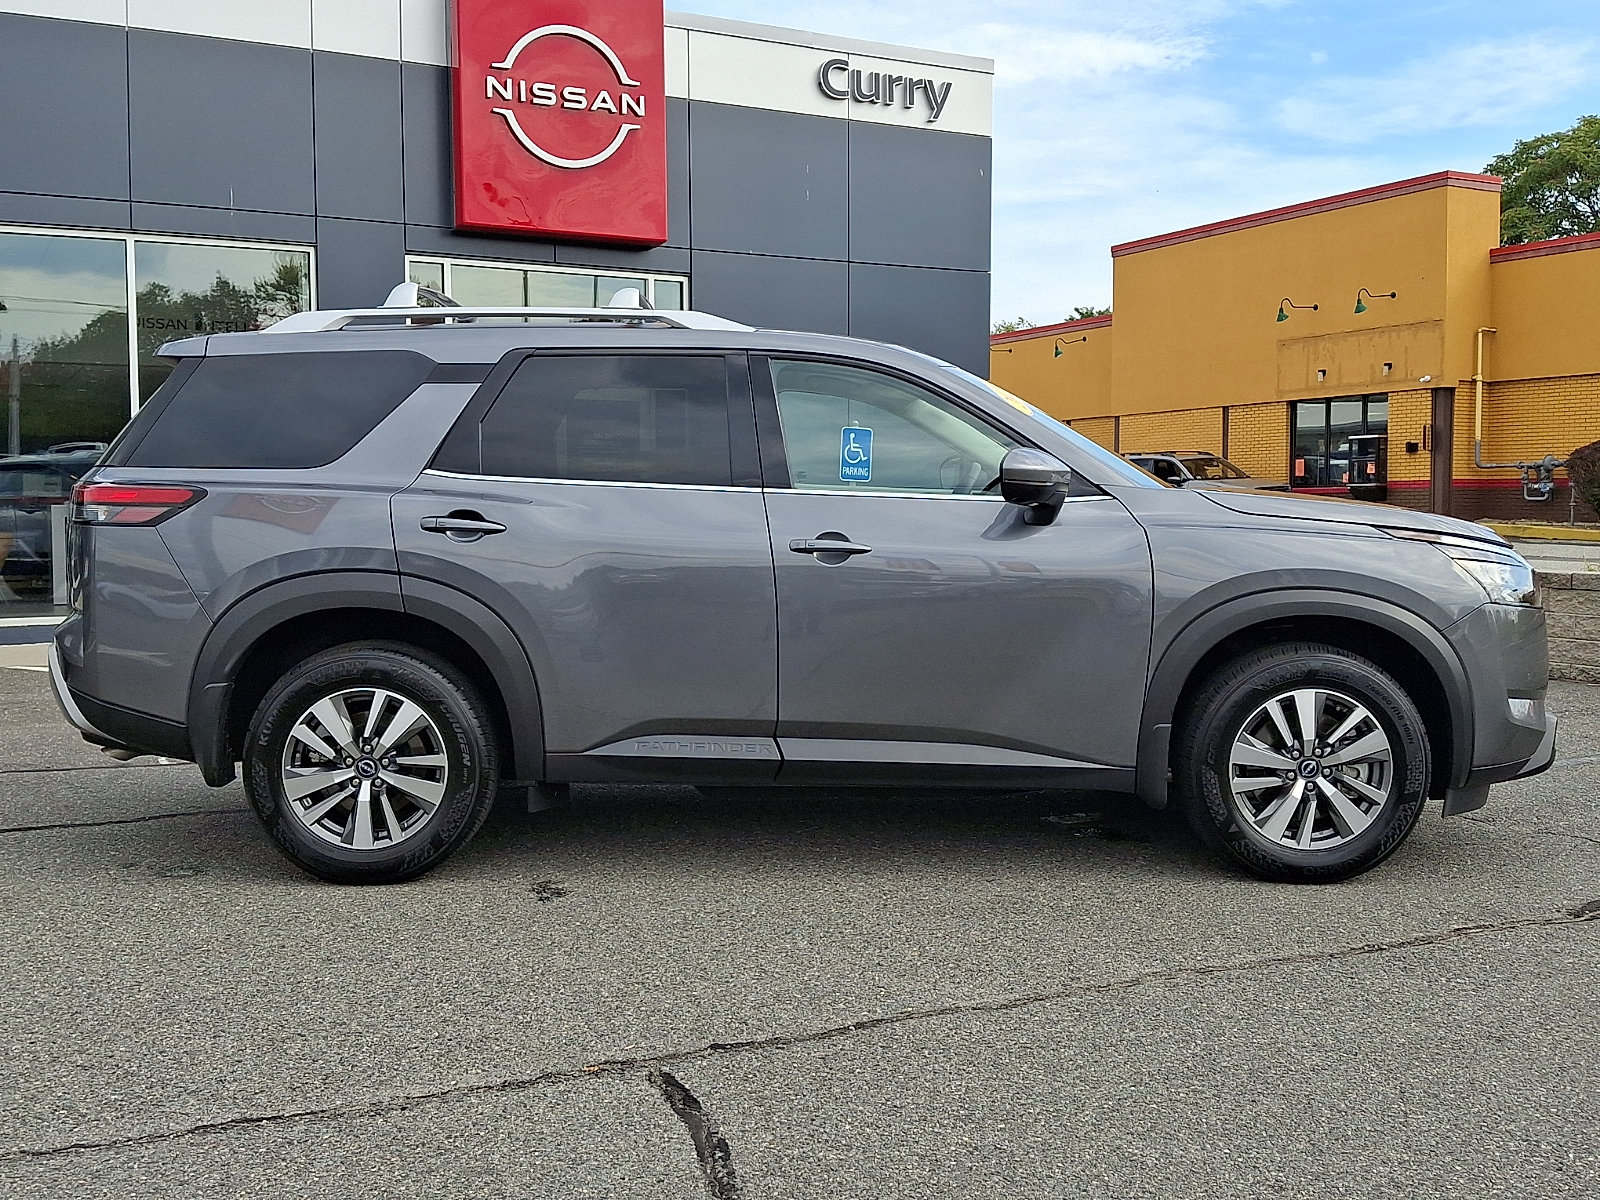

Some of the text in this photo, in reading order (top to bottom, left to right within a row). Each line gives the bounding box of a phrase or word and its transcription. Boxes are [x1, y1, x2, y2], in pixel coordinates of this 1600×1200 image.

[485, 75, 646, 117] NISSAN
[817, 58, 953, 122] Curry
[137, 318, 187, 330] ISSAN
[842, 466, 869, 476] PARKING
[634, 741, 773, 755] PATHFINDER
